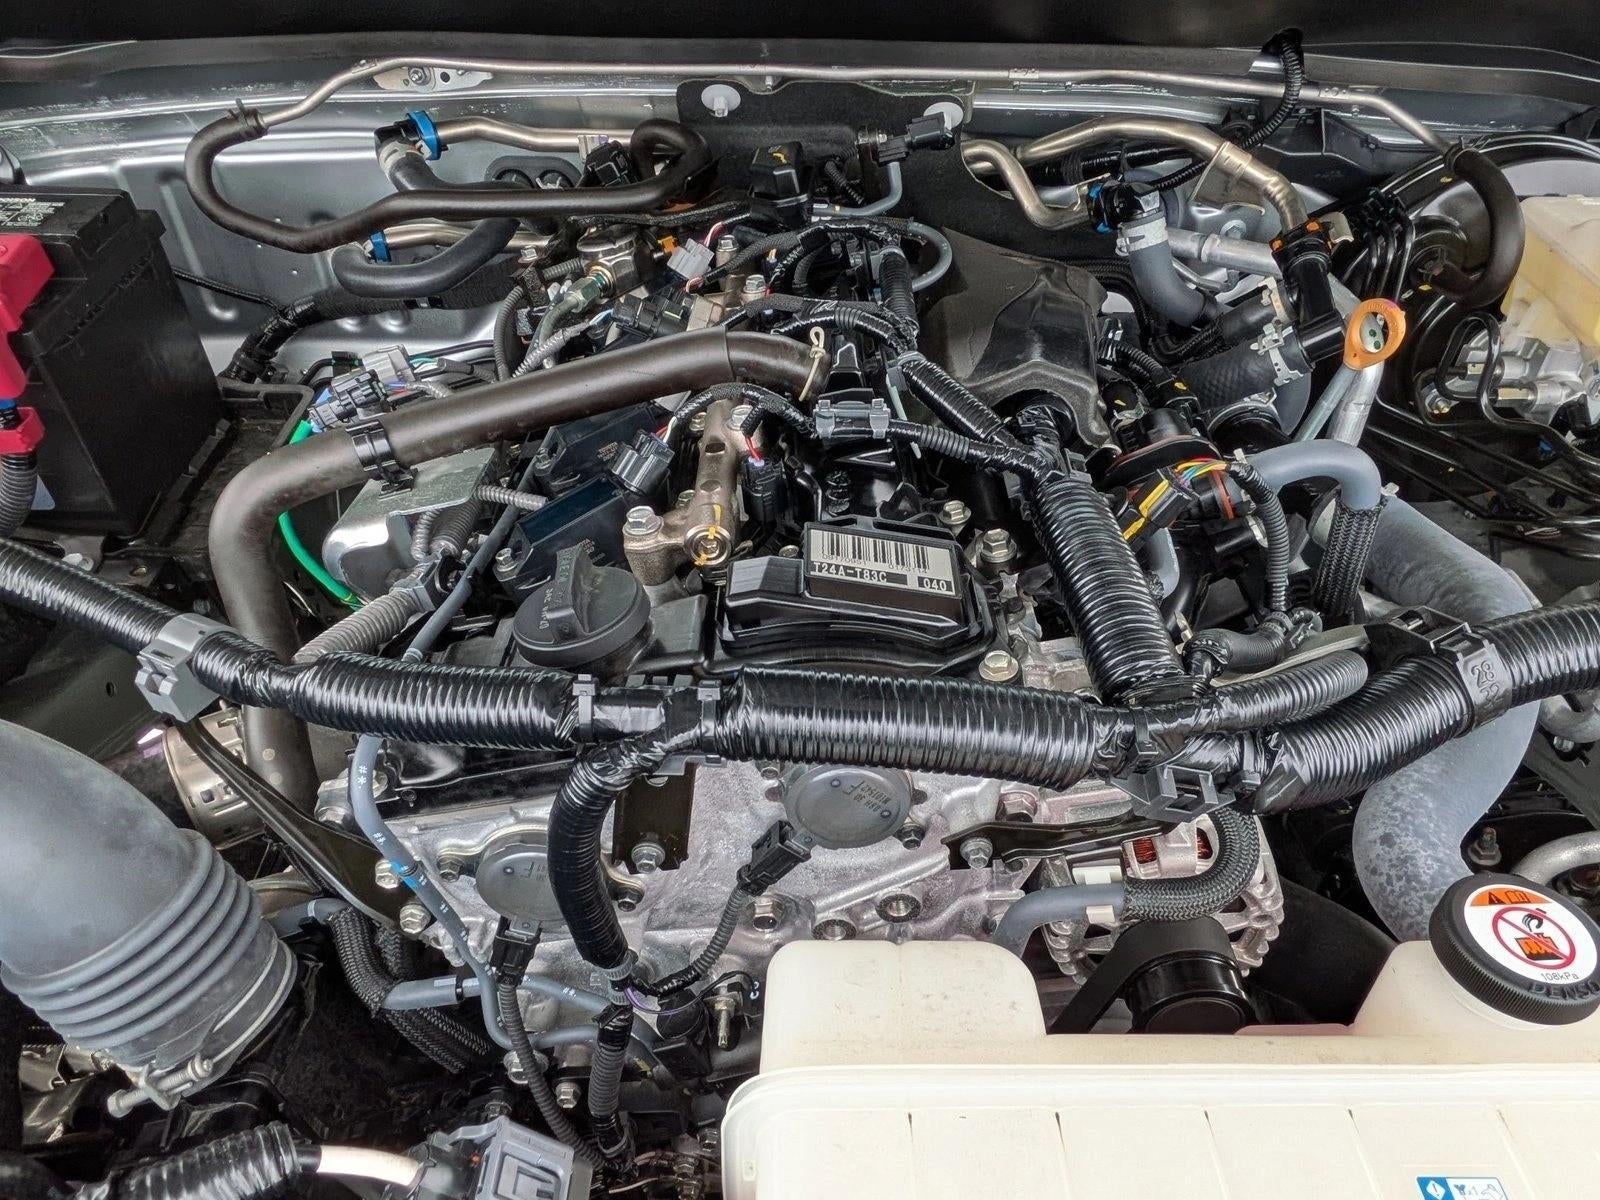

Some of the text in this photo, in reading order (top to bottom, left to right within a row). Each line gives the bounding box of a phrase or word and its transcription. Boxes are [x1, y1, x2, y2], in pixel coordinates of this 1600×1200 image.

[813, 561, 947, 591] T24A-T83C 040
[1471, 660, 1495, 688] 28
[1540, 971, 1580, 982] 108kPa
[1528, 981, 1600, 1000] DENSO
